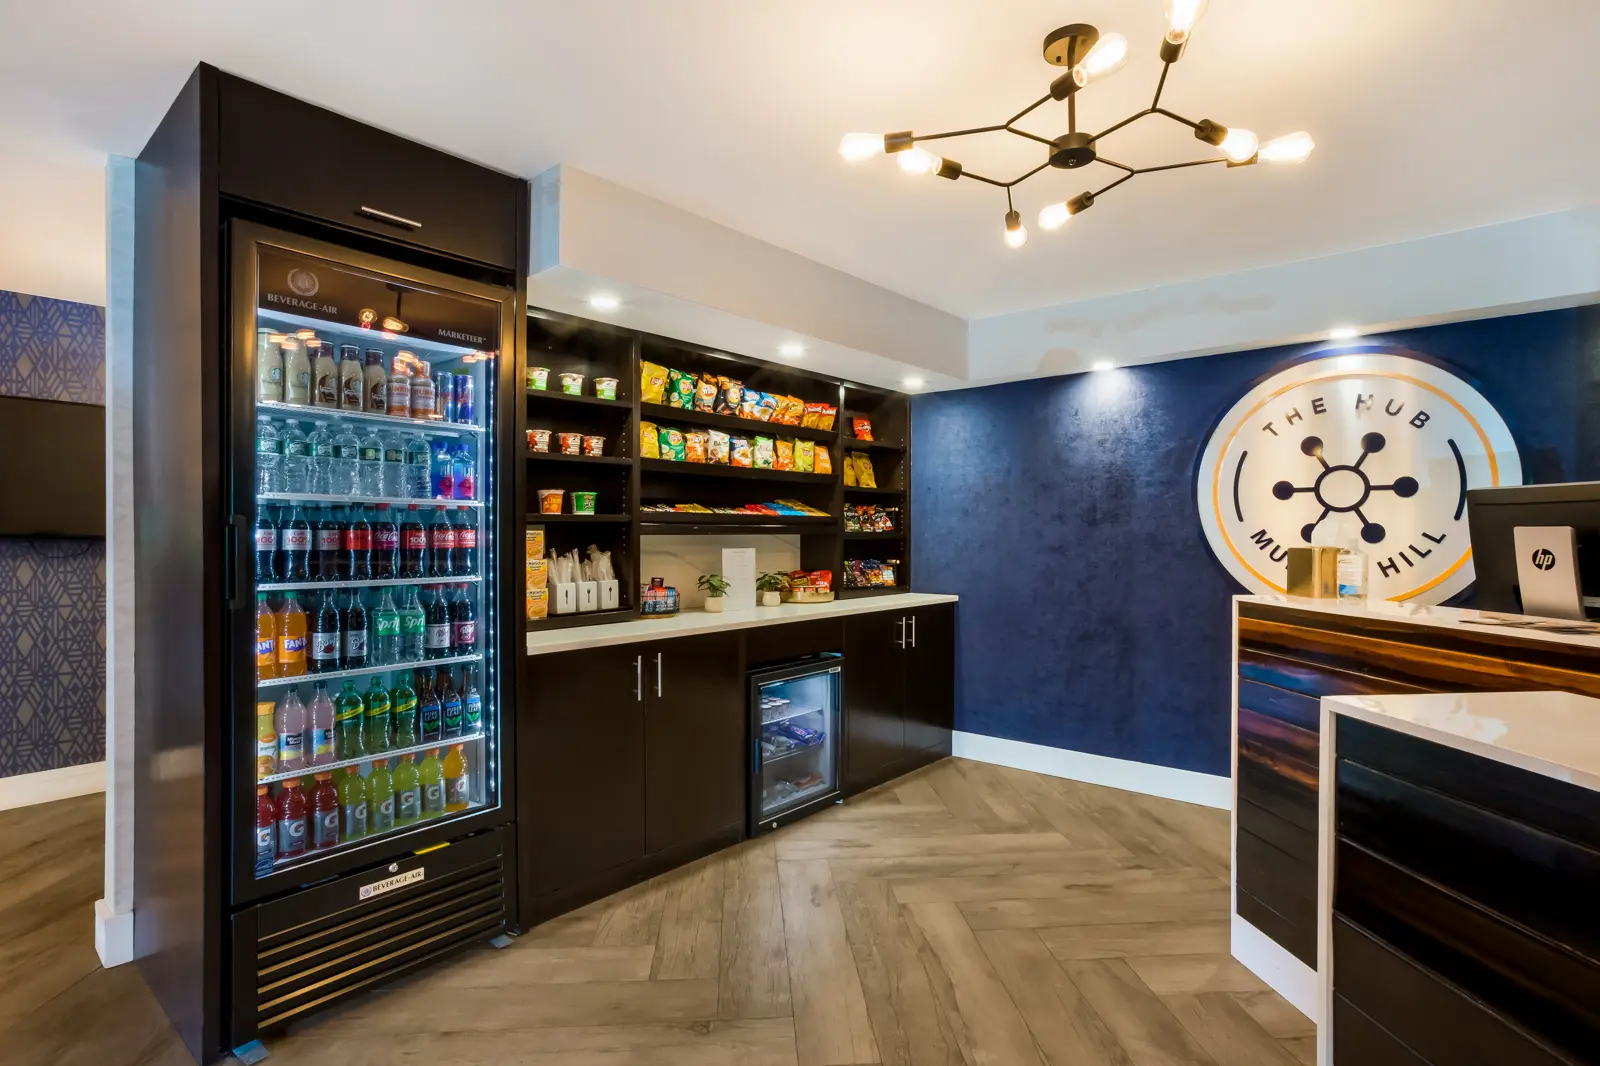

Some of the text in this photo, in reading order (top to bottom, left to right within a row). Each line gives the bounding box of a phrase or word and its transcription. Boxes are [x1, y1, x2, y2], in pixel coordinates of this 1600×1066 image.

[267, 293, 338, 315] BEVERAGE-AIR
[1261, 393, 1431, 437] THE HUB
[1250, 528, 1288, 570] MU
[1376, 531, 1447, 578] HILL
[1533, 548, 1554, 571] hp
[288, 821, 305, 837] G
[372, 871, 422, 892] BEVERAGE-AIR
